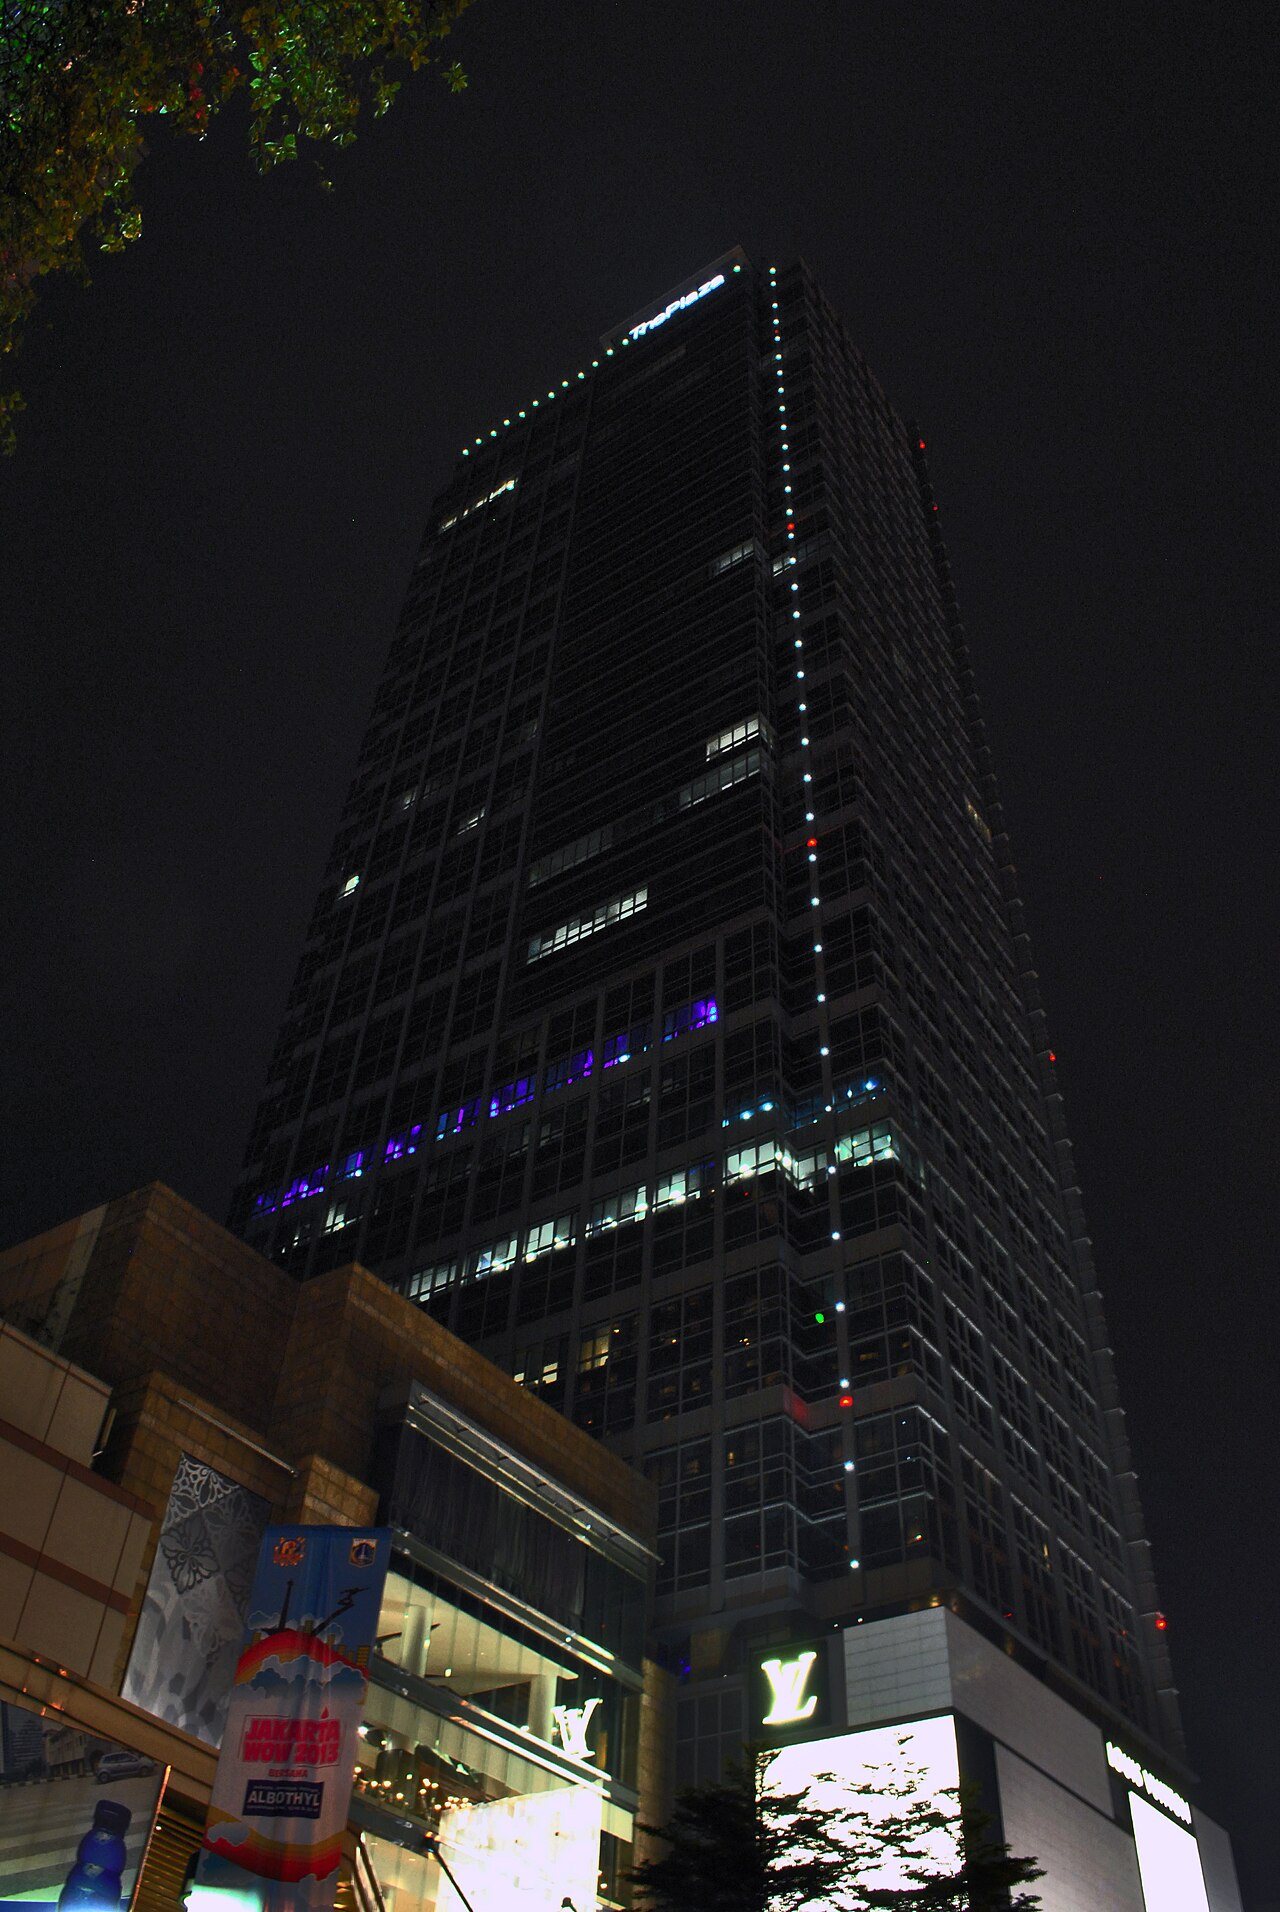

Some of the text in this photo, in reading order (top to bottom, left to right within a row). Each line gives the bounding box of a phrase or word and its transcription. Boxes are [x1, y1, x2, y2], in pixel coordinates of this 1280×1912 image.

[245, 1718, 340, 1742] JAKARTA
[295, 1742, 339, 1764] 2013
[247, 1790, 320, 1807] ALBOTHYL
